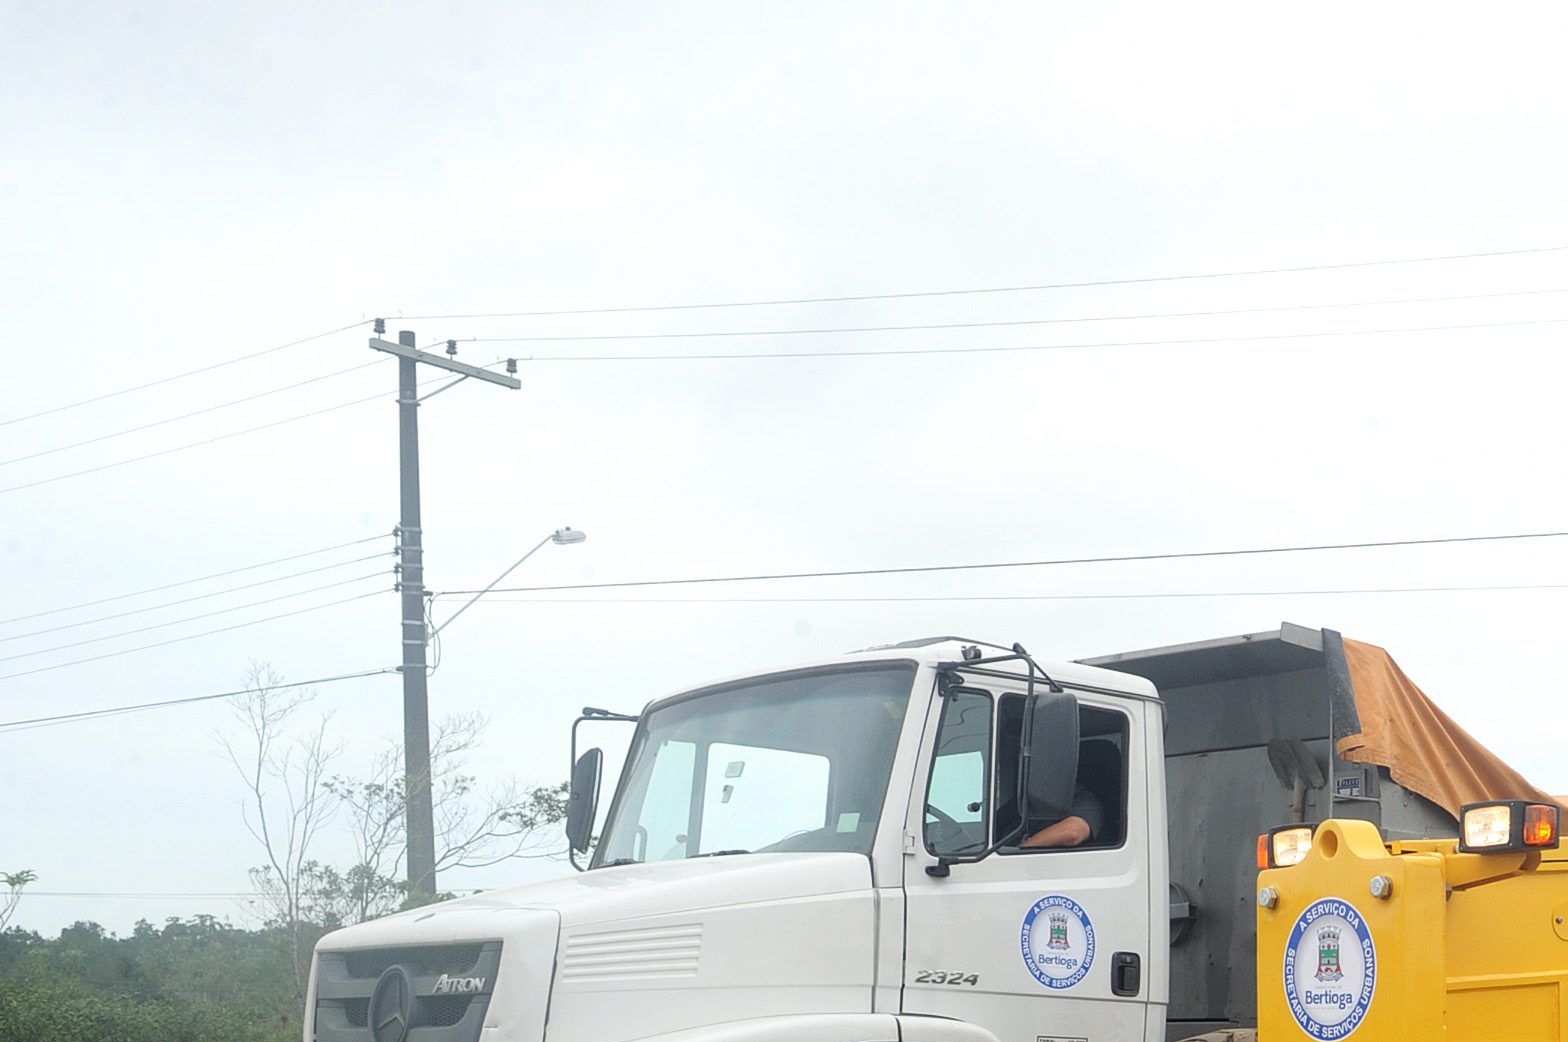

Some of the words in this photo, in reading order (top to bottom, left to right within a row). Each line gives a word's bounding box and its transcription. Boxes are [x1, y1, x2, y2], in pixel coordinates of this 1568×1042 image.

[1033, 906, 1040, 915] A
[1039, 897, 1072, 909] SERVIÇO
[1073, 906, 1084, 918] DA
[1299, 918, 1307, 932] A
[1306, 902, 1346, 920] SERVIÇO
[1346, 911, 1360, 929] DA
[1022, 923, 1040, 978] SECRETARIA
[1040, 975, 1051, 985] DE
[1051, 968, 1086, 988] SERVIÇOS
[1083, 925, 1094, 967] URBANOS
[1038, 954, 1078, 970] Bertioga
[431, 973, 486, 994] ATRON
[915, 969, 979, 986] 2324
[1286, 947, 1308, 1026] SECRETARIA
[1307, 1020, 1320, 1036] DE
[1321, 1007, 1364, 1038] SERVIÇOS
[1360, 938, 1374, 1005] URBANOS
[1305, 990, 1353, 1010] Bertioga
